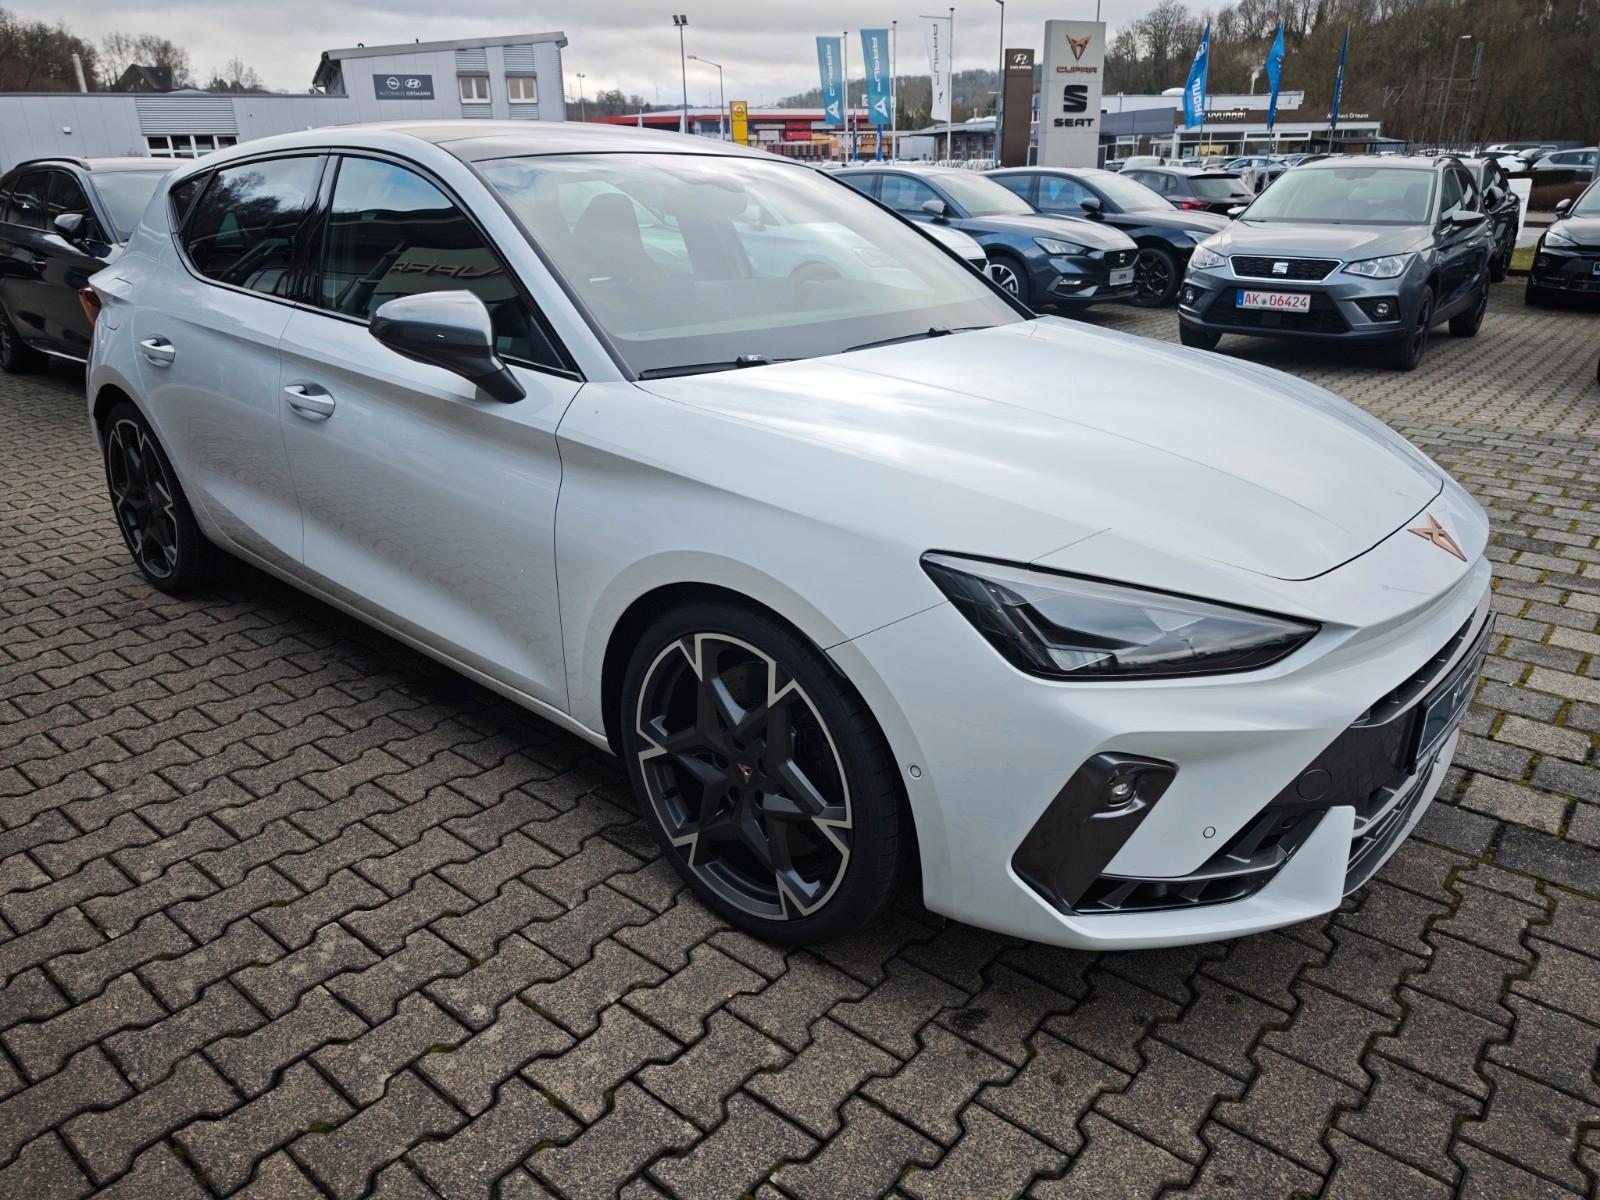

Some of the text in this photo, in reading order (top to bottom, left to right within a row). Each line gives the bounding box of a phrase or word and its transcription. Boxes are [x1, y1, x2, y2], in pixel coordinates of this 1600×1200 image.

[1056, 66, 1097, 74] CUPRA
[1207, 112, 1246, 121] HYUNDAI
[1053, 118, 1095, 128] SEAT
[1244, 293, 1308, 308] AK 06424
